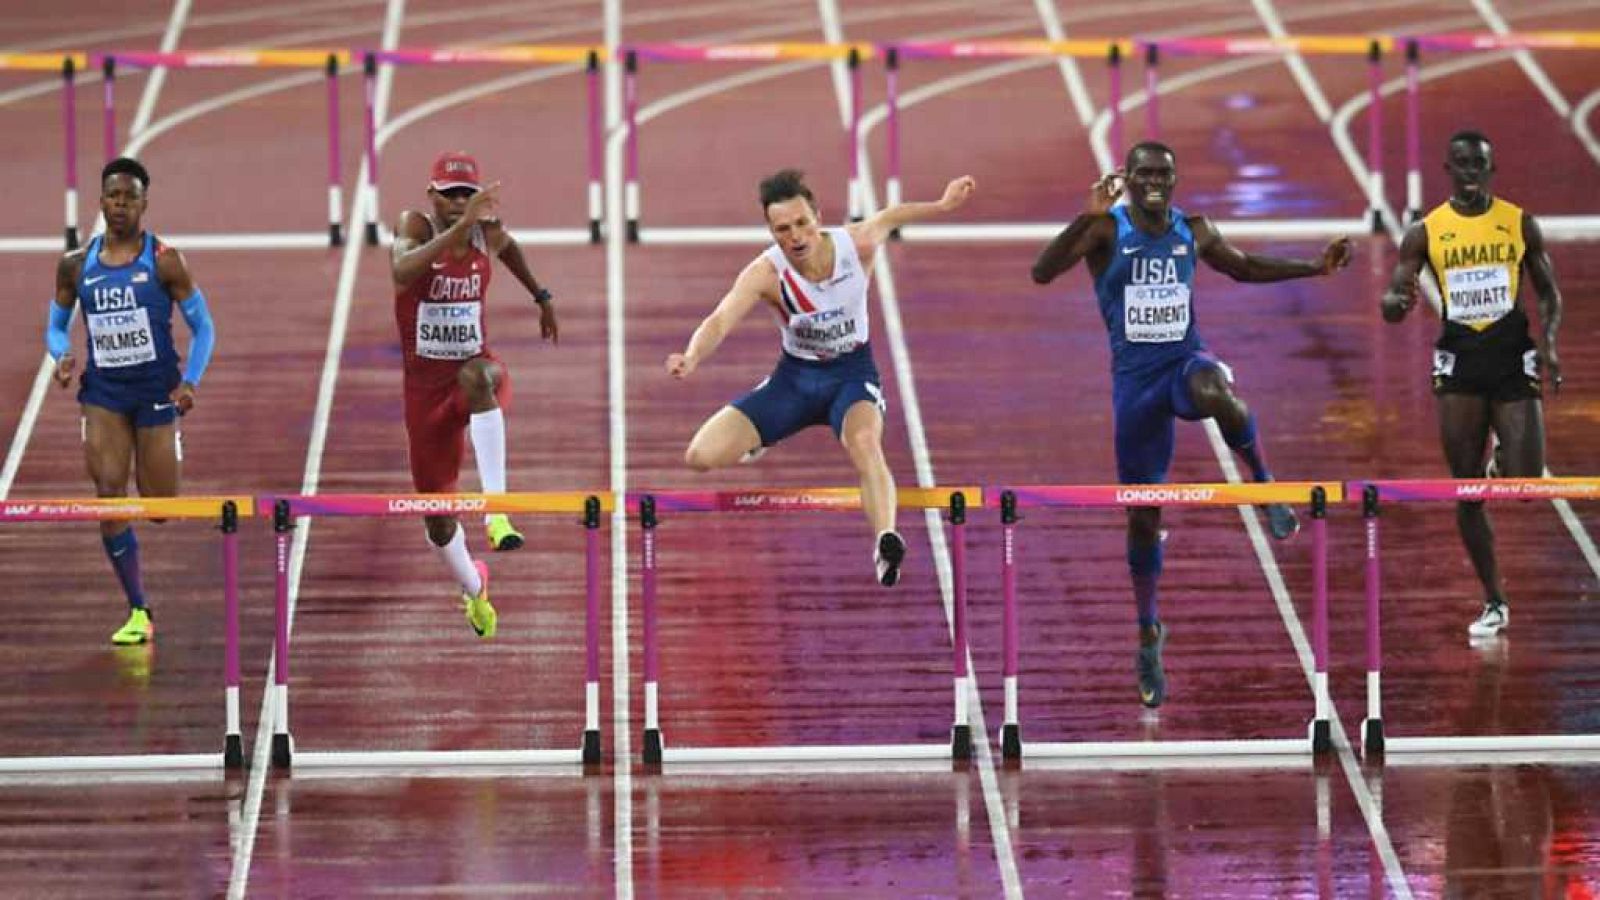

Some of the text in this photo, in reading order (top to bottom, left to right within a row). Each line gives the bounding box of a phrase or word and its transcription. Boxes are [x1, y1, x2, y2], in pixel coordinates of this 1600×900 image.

[1443, 243, 1517, 270] JAMAICA
[1132, 257, 1178, 284] USA
[94, 285, 137, 312] USA
[429, 274, 481, 300] QATAR
[1150, 287, 1178, 299] TDK
[1449, 285, 1508, 308] MOWATT
[441, 306, 474, 318] TDK
[1127, 303, 1187, 326] CLEMENT
[94, 328, 150, 351] HOLMES
[420, 323, 478, 343] SAMBA
[388, 498, 487, 512] LONDON 2017
[1116, 488, 1216, 503] LONDON 2017
